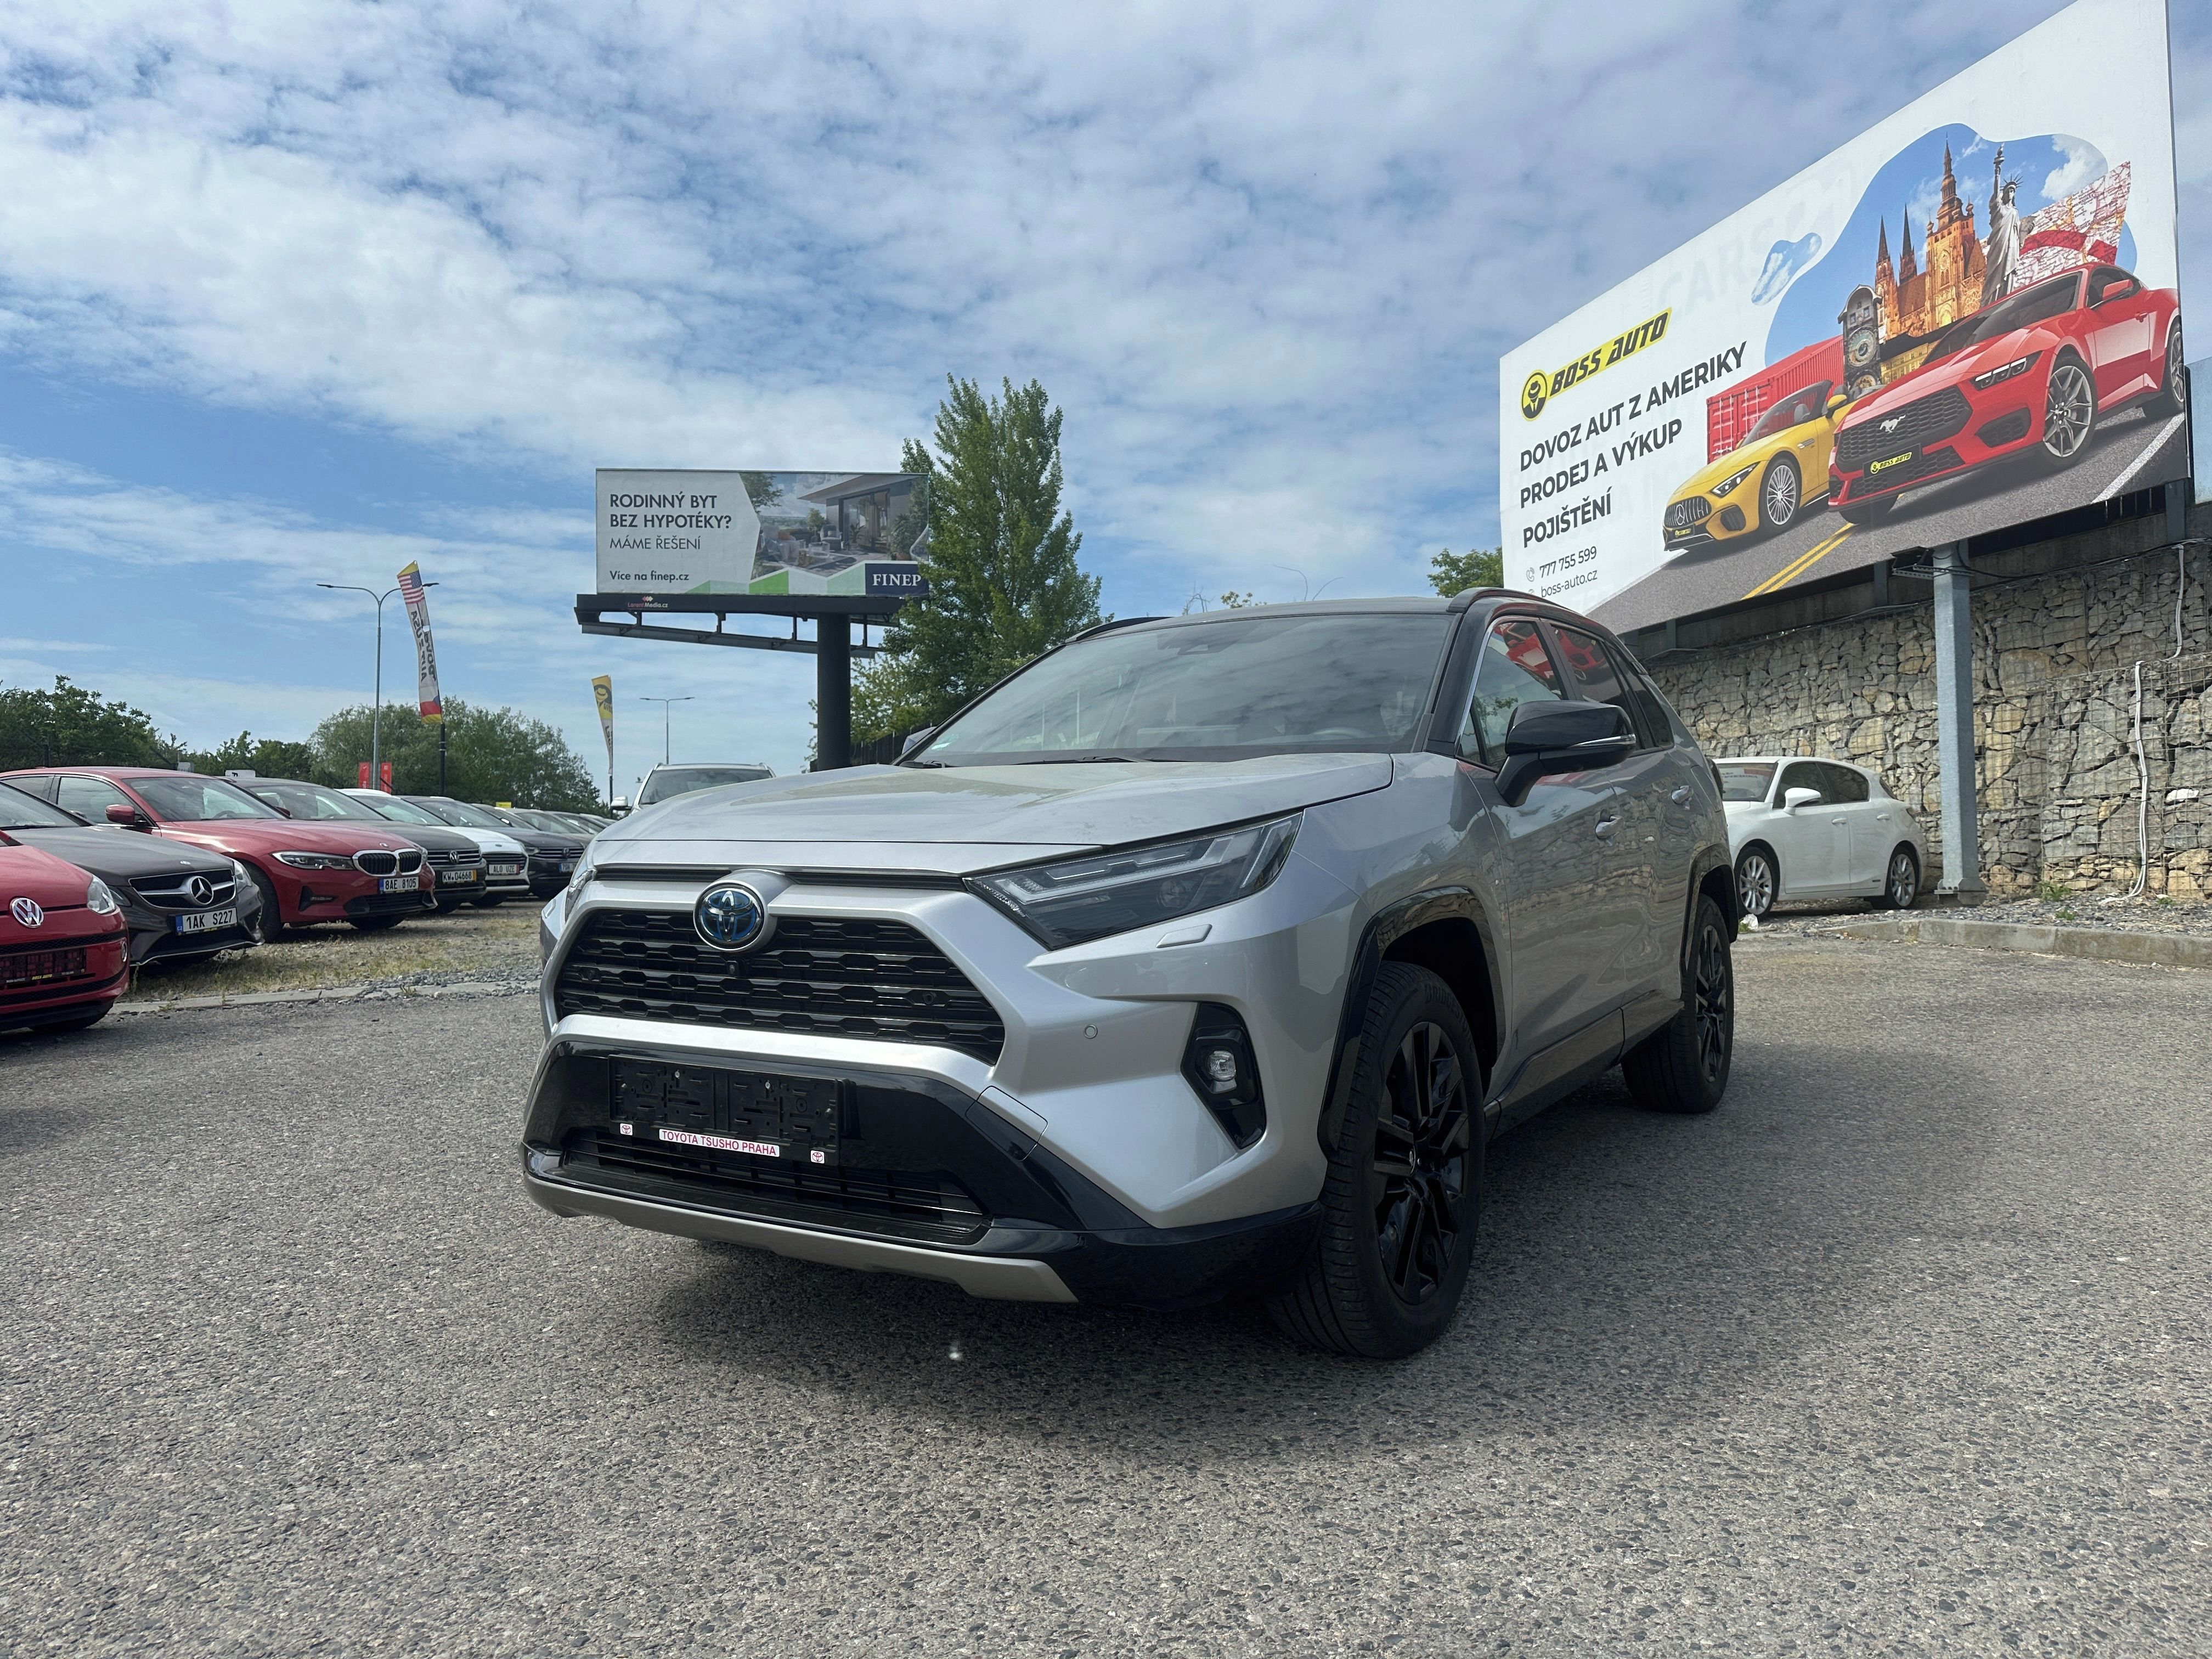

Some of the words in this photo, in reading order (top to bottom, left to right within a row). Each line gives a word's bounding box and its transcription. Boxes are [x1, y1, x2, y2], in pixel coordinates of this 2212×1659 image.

[1549, 348, 1602, 397] BOSS
[1605, 312, 1669, 366] AUTO
[1520, 422, 1582, 472] DOVOZ
[1585, 402, 1624, 440] AUT
[1628, 394, 1642, 420] Z
[1645, 341, 1747, 413] AMERIKY
[1520, 460, 1589, 508] PRODEJ
[1593, 453, 1608, 477] A
[1612, 419, 1682, 467] VÝKUP
[610, 491, 685, 508] RODINNÝ
[690, 495, 717, 509] BYT
[610, 513, 637, 528] BEZ
[644, 511, 732, 529] HYPOTÉKY?
[1523, 486, 1612, 548] POJIŠTĚNÍ
[610, 534, 651, 549] MÁME
[656, 535, 701, 550] ŘEŠENÍ
[1539, 561, 1556, 578] 777
[1559, 554, 1576, 571] 755
[1578, 546, 1597, 564] 599
[610, 570, 631, 580] Více
[650, 570, 690, 583] finep.cz
[872, 573, 922, 587] FINEP
[1541, 569, 1598, 598] boss-auto.cz
[385, 879, 398, 890] 8AE
[402, 878, 416, 888] 8105
[186, 915, 205, 929] 1AK
[212, 910, 233, 926] S227
[662, 1130, 698, 1146] TOYOTA
[701, 1135, 740, 1150] TSUSHO
[742, 1140, 776, 1156] PRAHA
